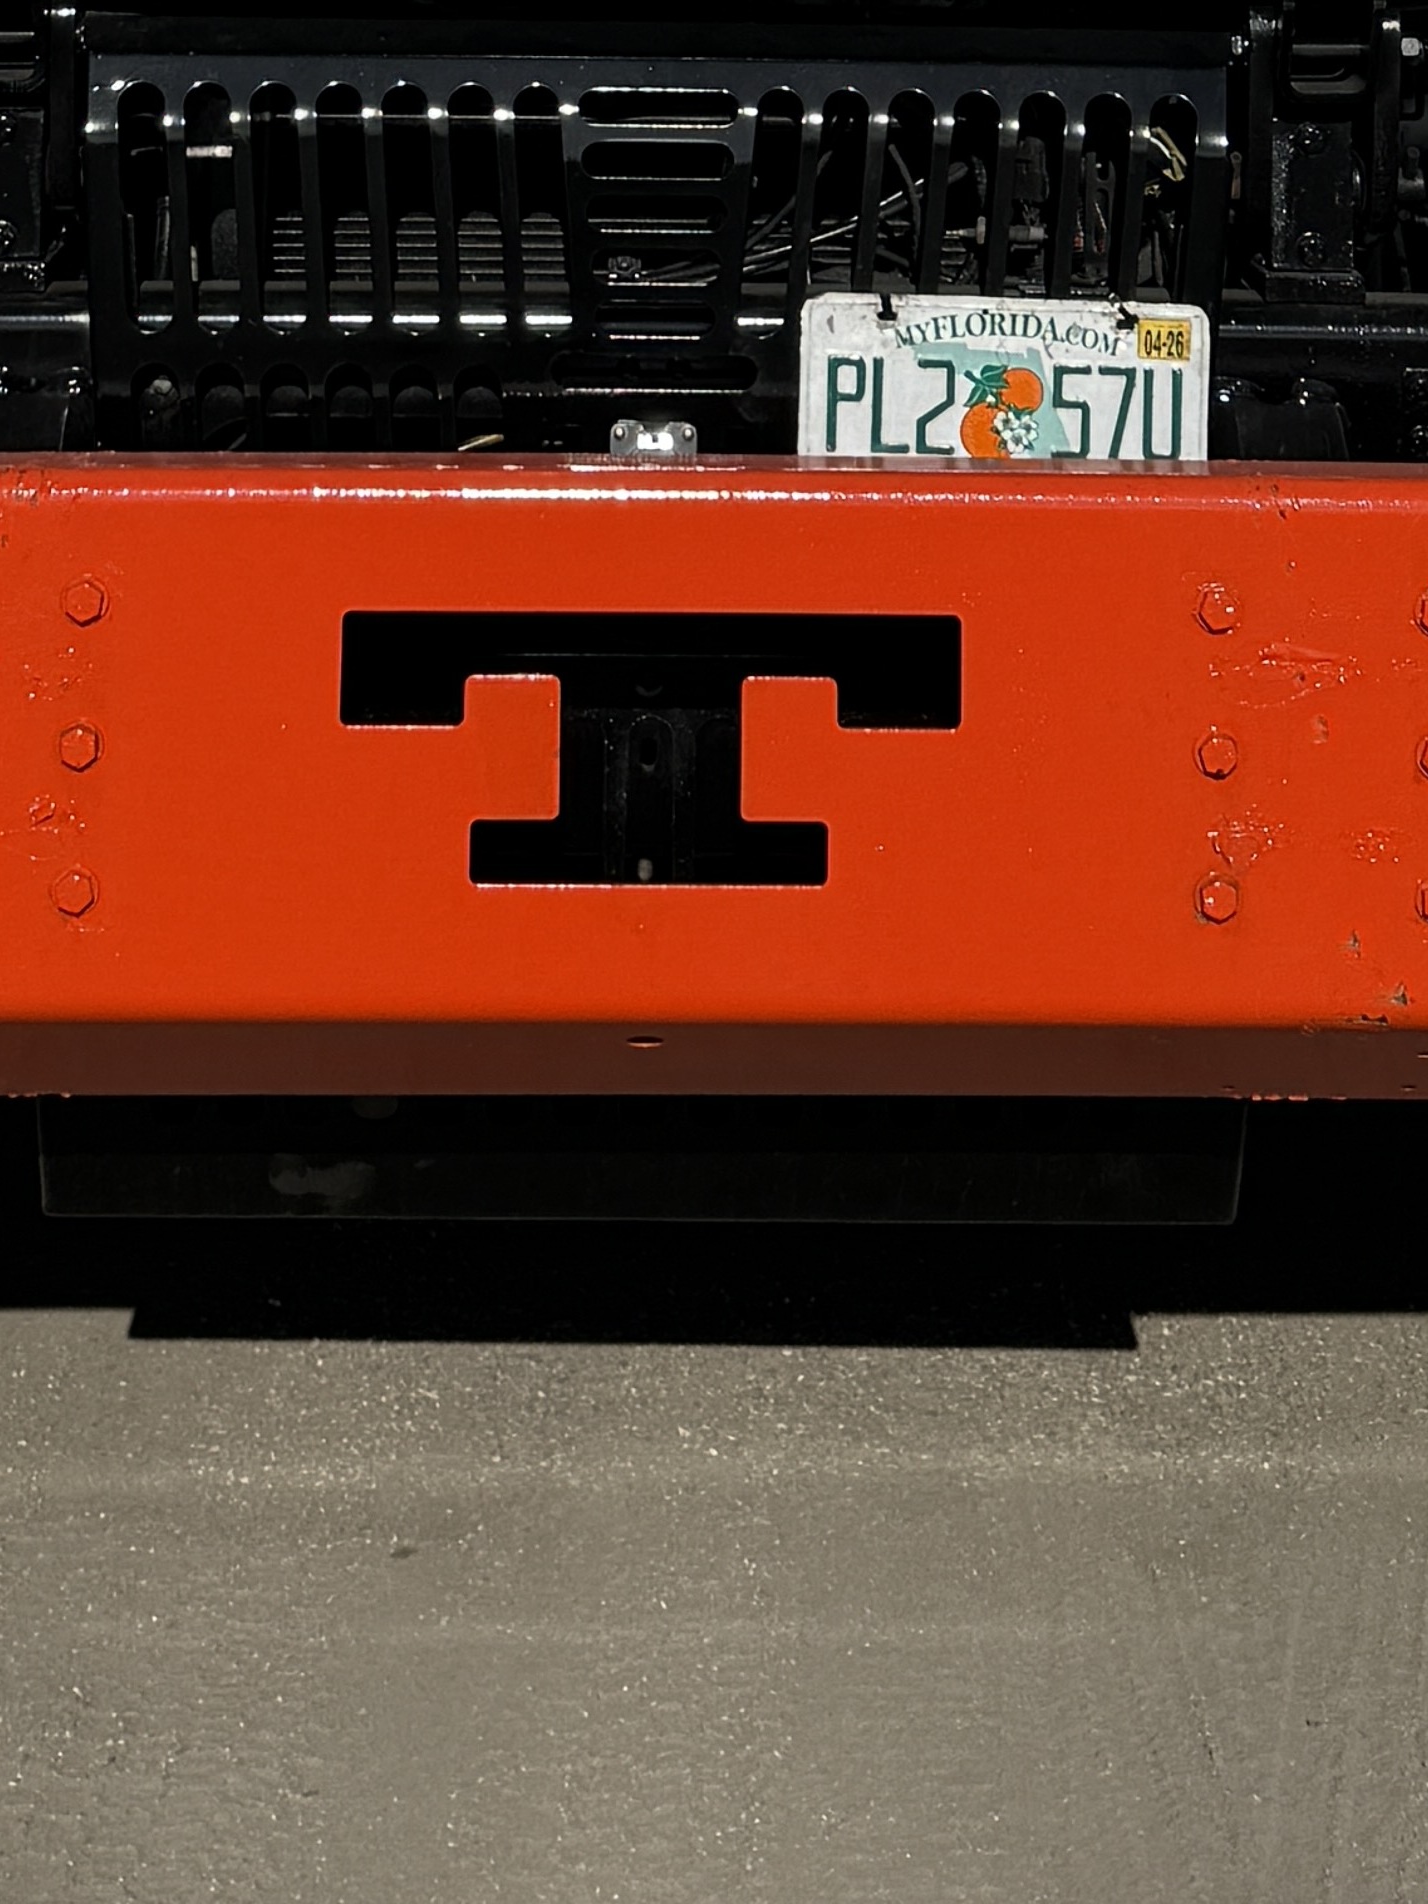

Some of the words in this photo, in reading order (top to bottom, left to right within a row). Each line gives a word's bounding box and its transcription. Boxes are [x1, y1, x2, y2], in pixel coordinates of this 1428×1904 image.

[895, 311, 1120, 356] MYFLORIDA.COM
[1143, 328, 1185, 360] 04-26
[827, 354, 956, 455] PL2
[1050, 364, 1183, 460] 57U
